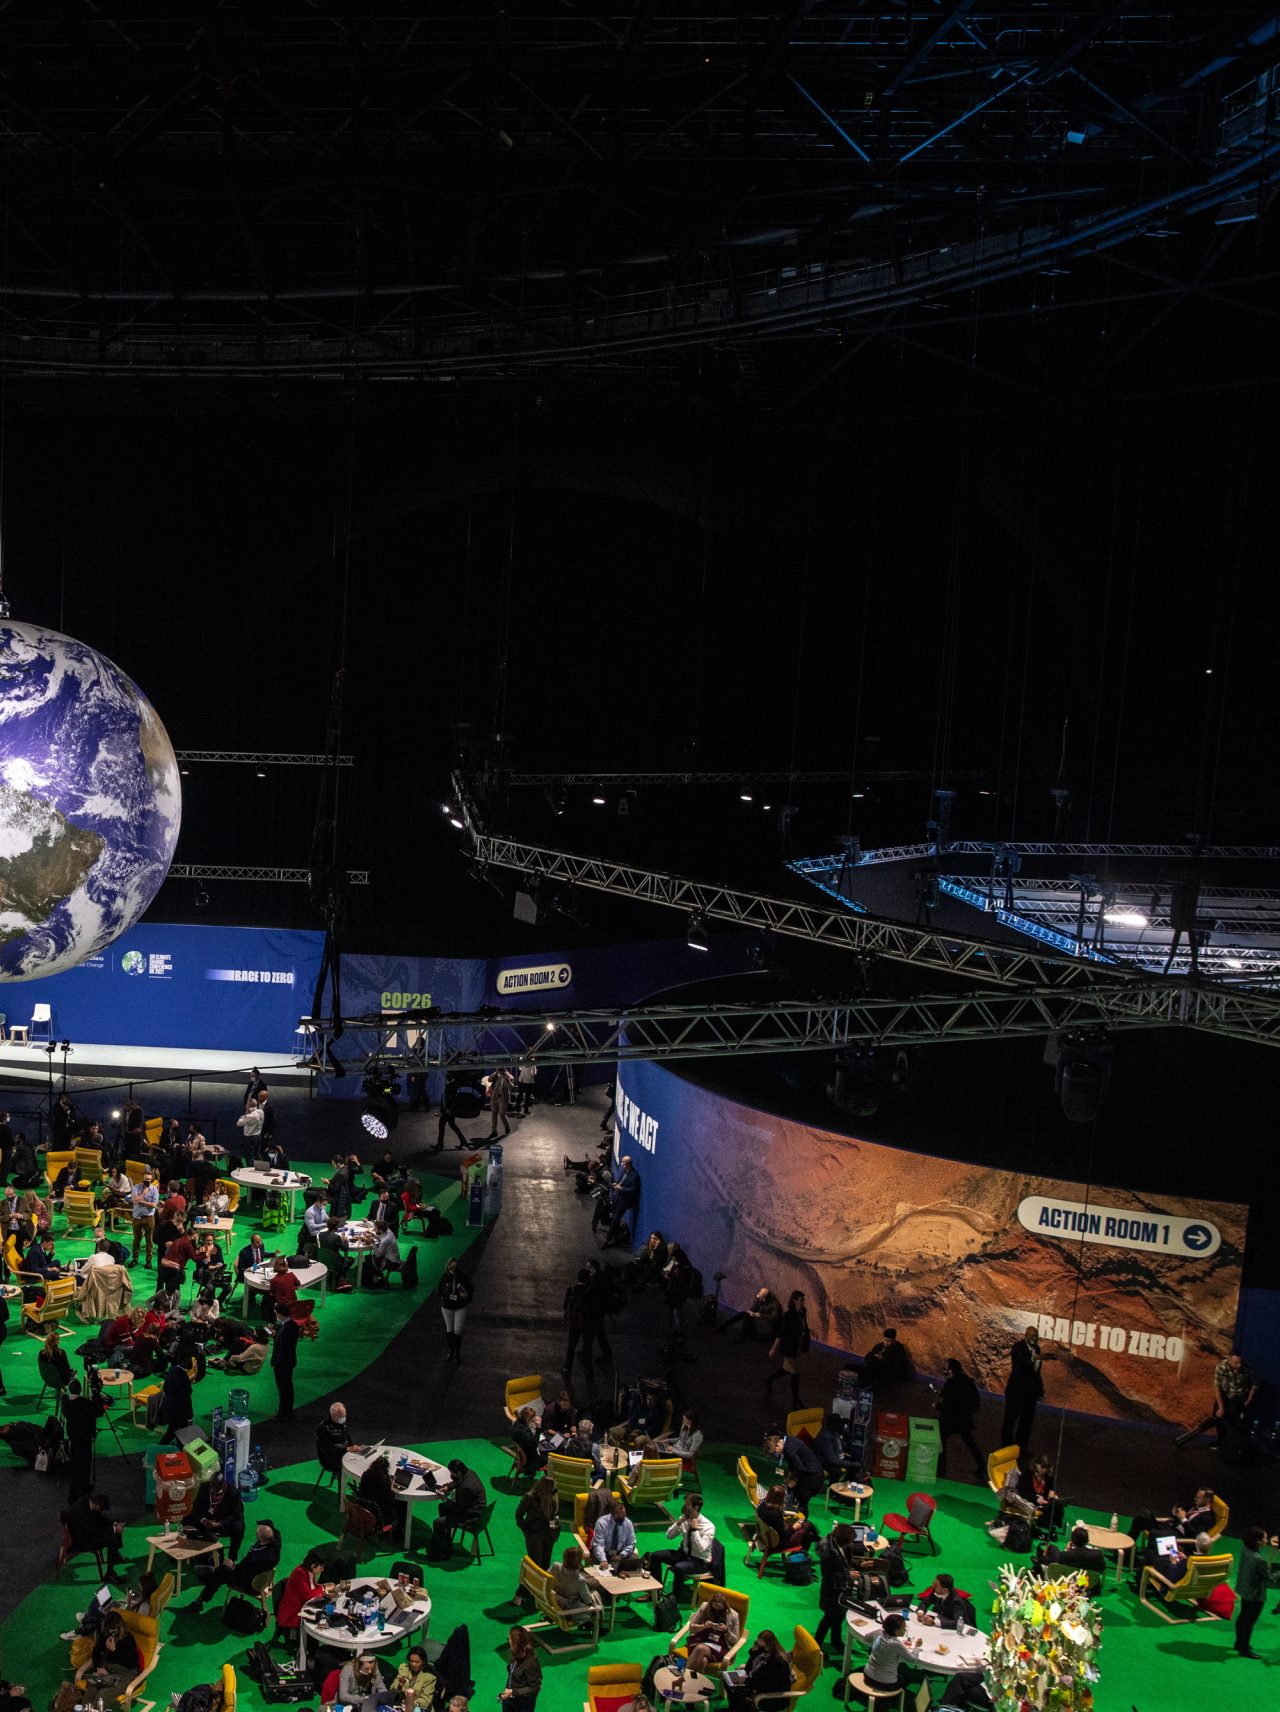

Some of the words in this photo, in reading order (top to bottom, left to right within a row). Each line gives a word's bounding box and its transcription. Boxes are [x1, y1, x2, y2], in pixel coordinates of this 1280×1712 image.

[234, 970, 259, 982] RACE
[260, 971, 271, 983] TO
[271, 972, 294, 984] ZERO
[504, 973, 529, 989] ACTION
[529, 971, 550, 986] ROOM
[550, 970, 556, 983] 2
[381, 991, 432, 1009] COP26
[629, 1099, 640, 1141] WE
[639, 1111, 659, 1155] ACT
[1038, 1206, 1102, 1235] ACTION
[1104, 1216, 1157, 1244] ROOM
[1162, 1224, 1170, 1245] 1
[1038, 1313, 1097, 1348] RACE
[1099, 1324, 1126, 1353] TO
[1128, 1330, 1184, 1362] ZERO
